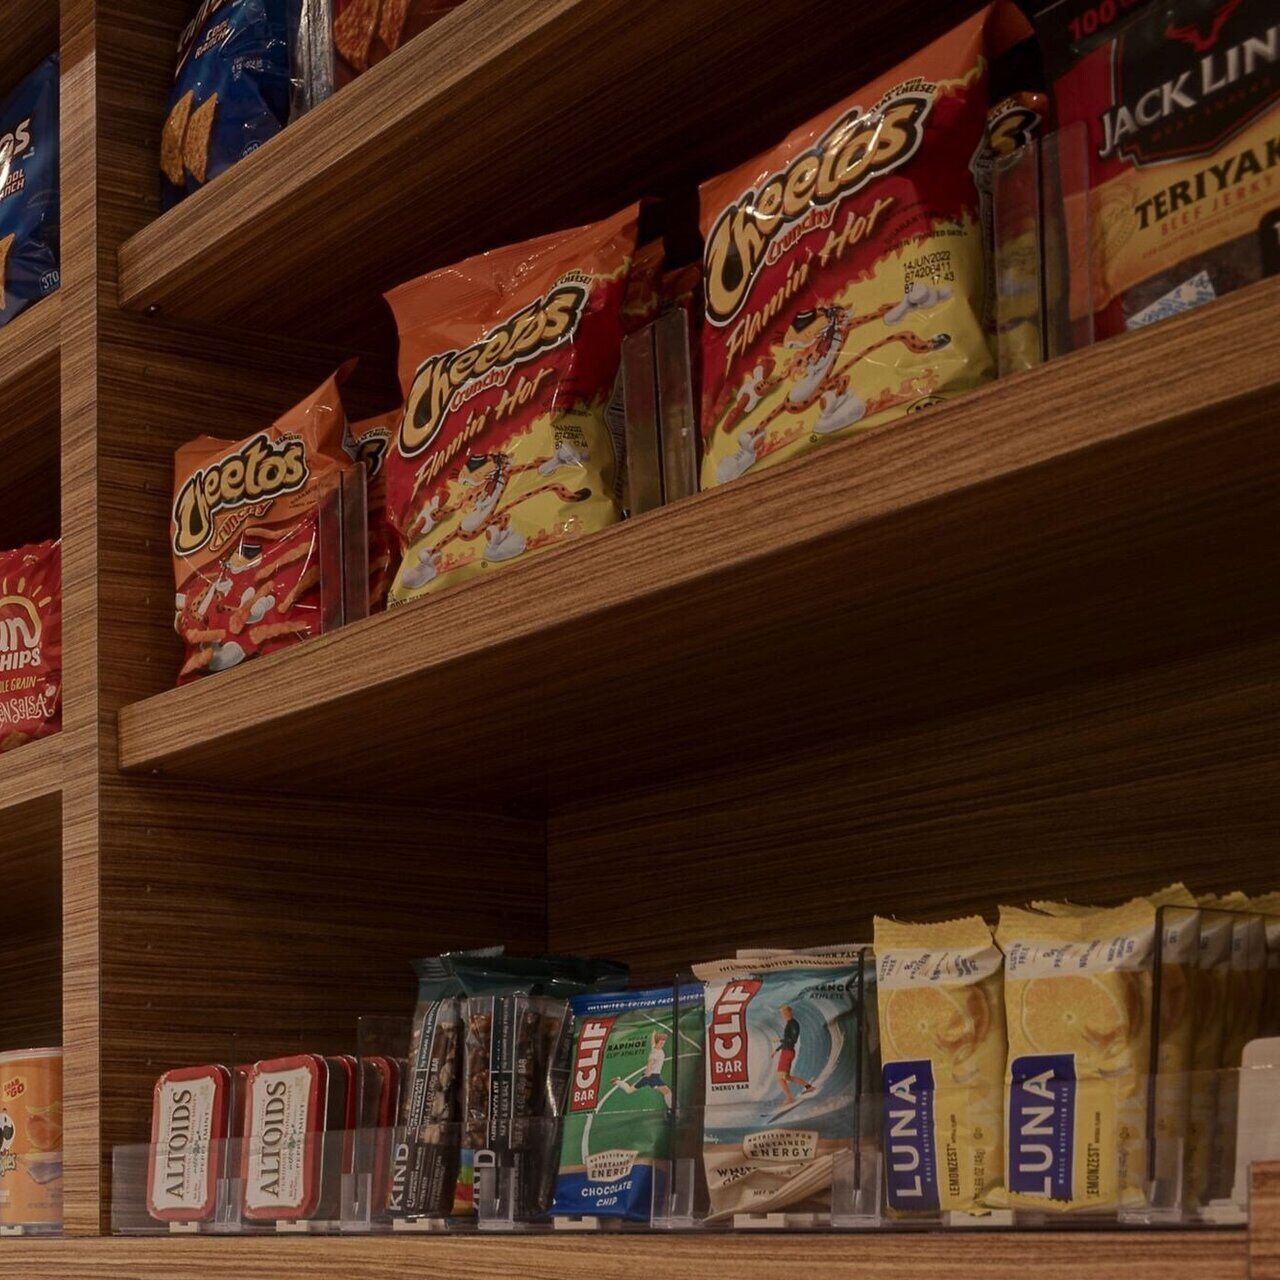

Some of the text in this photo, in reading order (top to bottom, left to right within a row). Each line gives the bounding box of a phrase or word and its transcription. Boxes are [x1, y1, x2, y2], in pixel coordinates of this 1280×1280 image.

[1099, 24, 1280, 157] JACK LIN
[706, 98, 929, 325] Cheetos
[1135, 137, 1280, 231] TERIYAK
[819, 197, 892, 266] Hot
[42, 270, 59, 289] 370
[401, 286, 586, 455] Cheetos
[497, 367, 554, 420] Hot
[576, 1022, 607, 1089] CLIF
[714, 985, 749, 1060] CLIF
[574, 1090, 594, 1102] BAR
[716, 1061, 742, 1073] BAR
[165, 1089, 192, 1200] ALTOIDS
[259, 1081, 286, 1197] ALTOIDS
[750, 1148, 811, 1158] ENERGY
[888, 1074, 923, 1197] LUNA
[1020, 1070, 1055, 1197] LUNA
[389, 1143, 410, 1211] KIND
[581, 1182, 632, 1197] CHOCOLATE
[596, 1196, 618, 1207] CHIP
